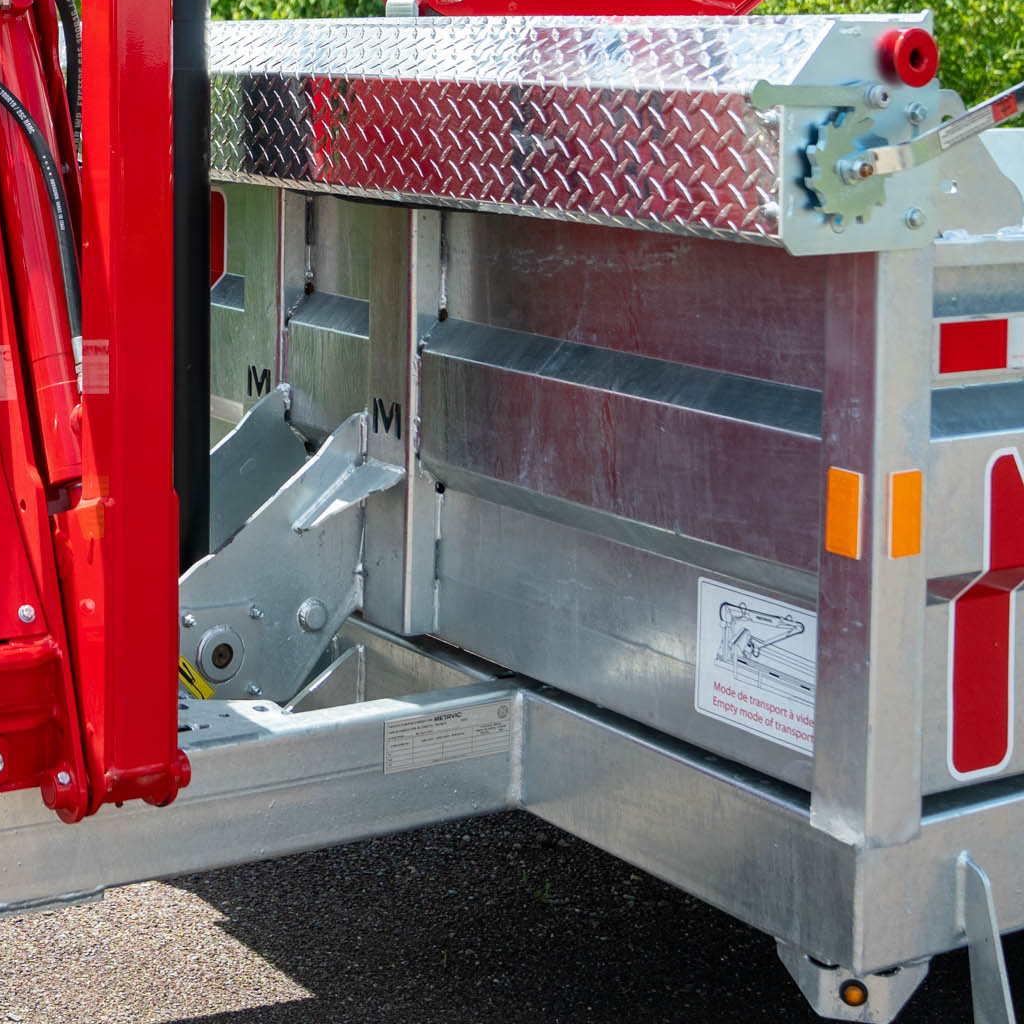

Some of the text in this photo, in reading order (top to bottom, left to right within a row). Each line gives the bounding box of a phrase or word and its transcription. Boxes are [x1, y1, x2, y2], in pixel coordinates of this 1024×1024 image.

[433, 711, 463, 722] METAVIC
[713, 681, 815, 727] Mode de transport à vide
[713, 695, 815, 744] Empty mode of transport
